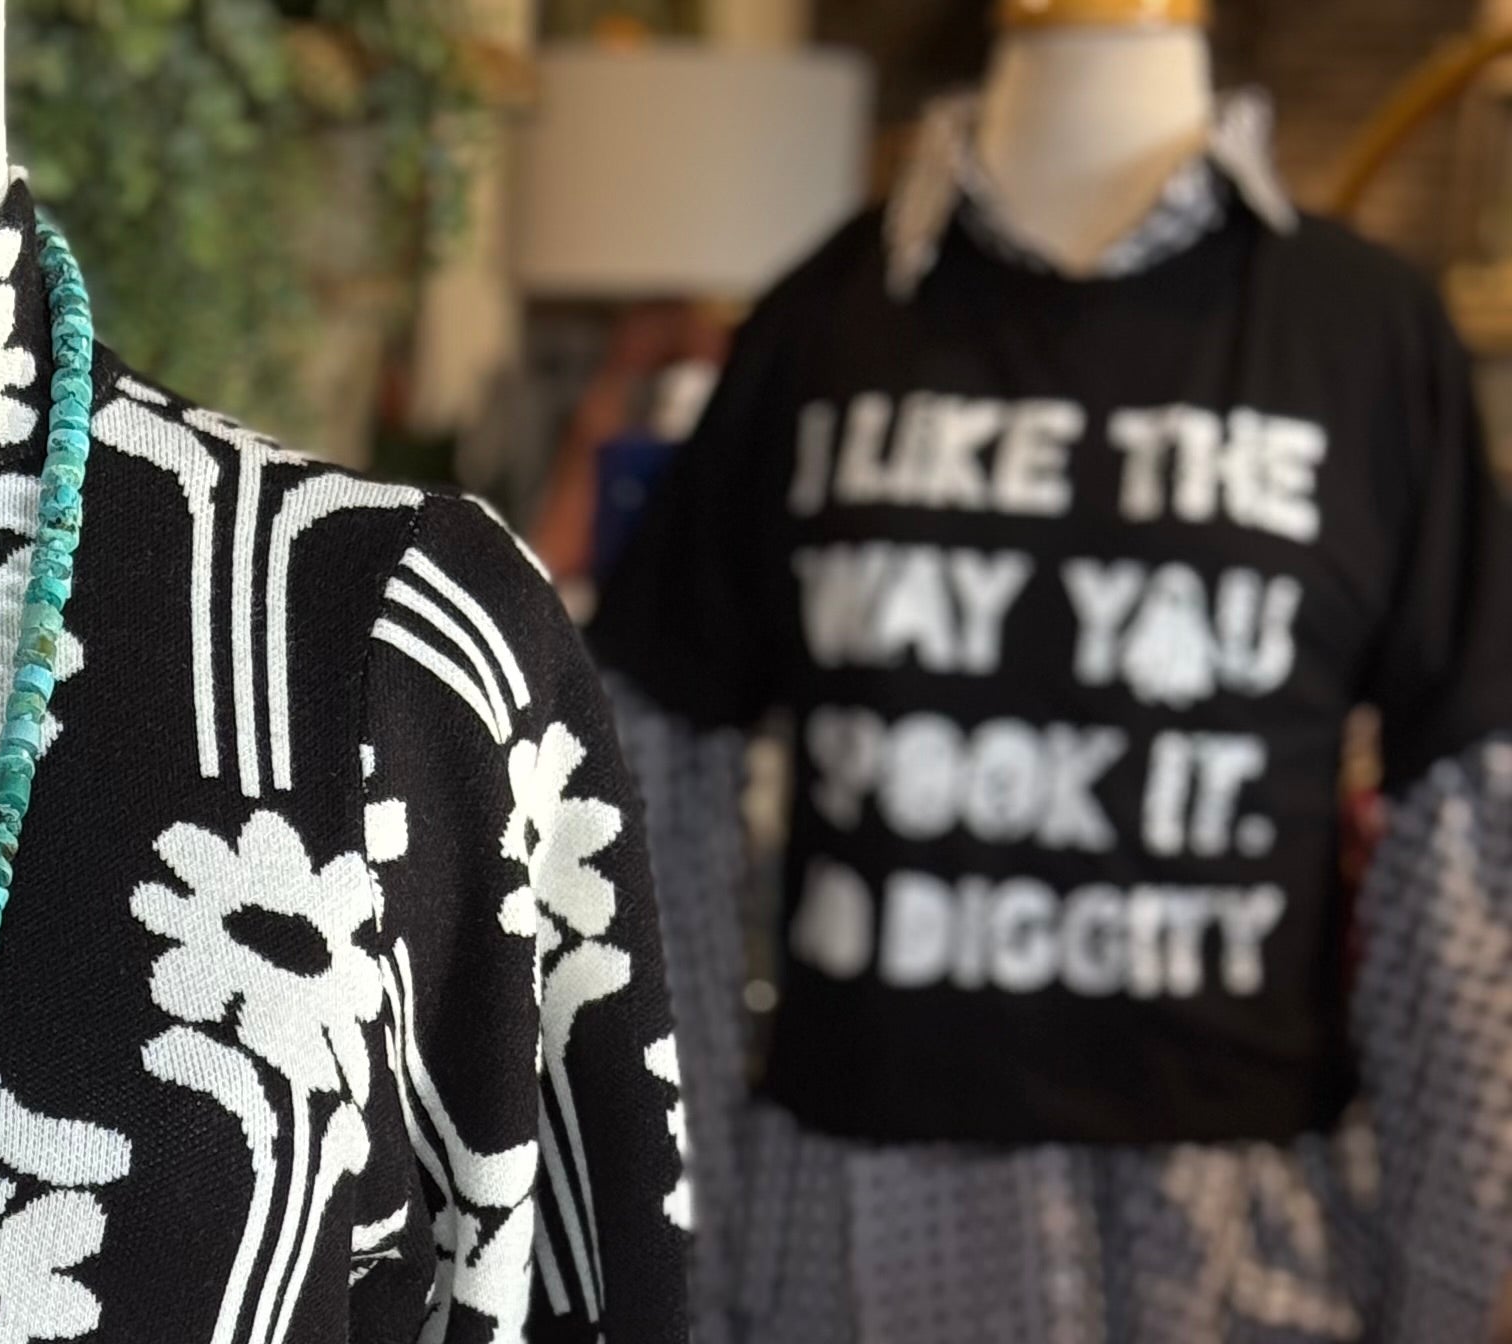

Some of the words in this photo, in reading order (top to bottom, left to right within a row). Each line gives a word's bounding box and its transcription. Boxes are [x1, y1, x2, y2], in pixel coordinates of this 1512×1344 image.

[792, 402, 836, 514] I
[835, 391, 1085, 516] LIKE
[1108, 402, 1327, 543] THE
[792, 539, 1033, 675] WAY
[1062, 556, 1301, 708] YOU
[1142, 730, 1276, 857] IT.
[879, 869, 1285, 1000] DIGGITY
